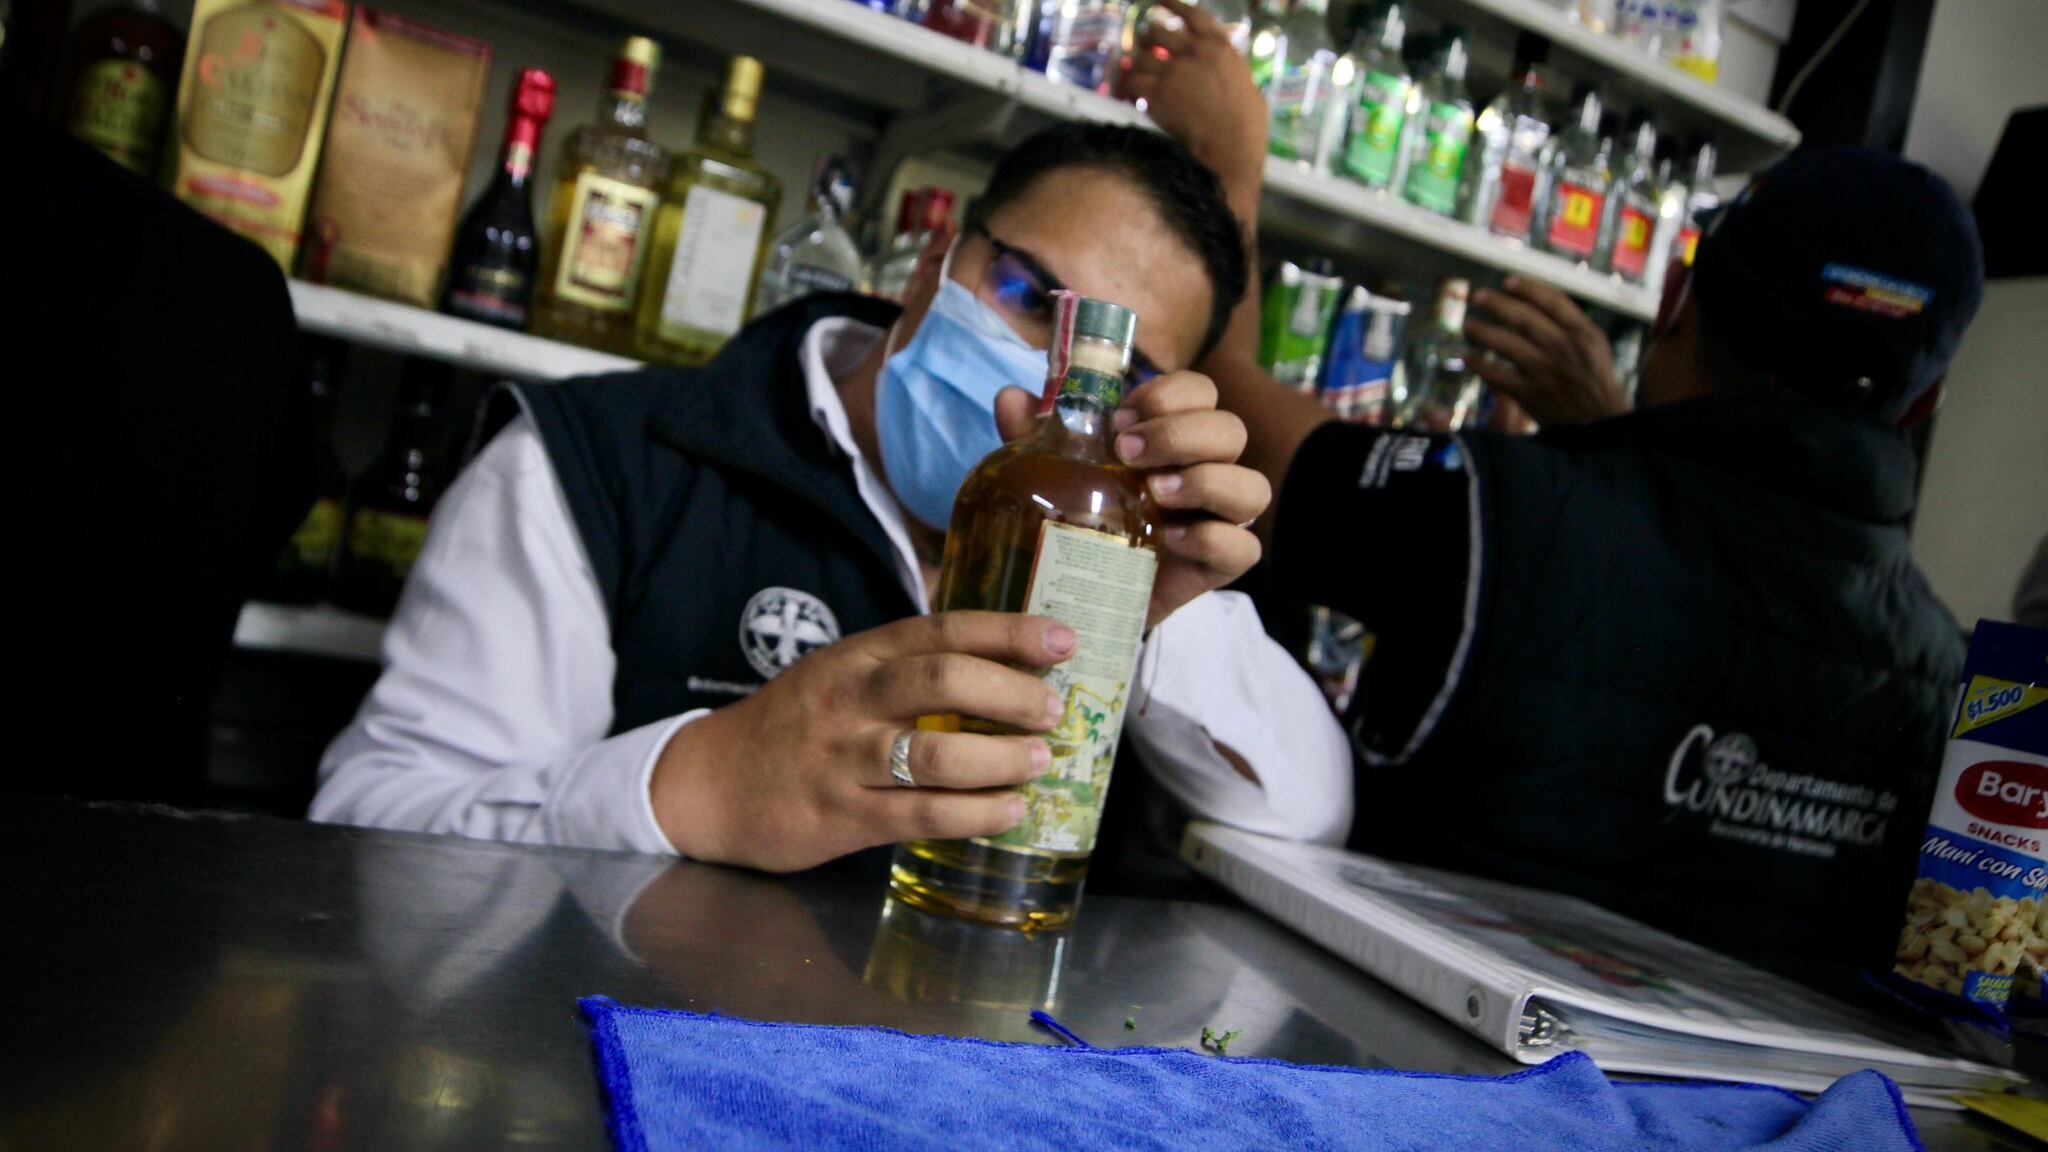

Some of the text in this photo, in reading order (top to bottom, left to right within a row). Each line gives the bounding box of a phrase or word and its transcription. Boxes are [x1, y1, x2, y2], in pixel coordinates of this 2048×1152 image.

[1966, 685, 2024, 721] $1.500
[1665, 723, 1889, 846] CUNDINAMARCA
[1967, 822, 2041, 853] SNACKS
[1920, 836, 1984, 866] Maní
[1978, 857, 2022, 880] con
